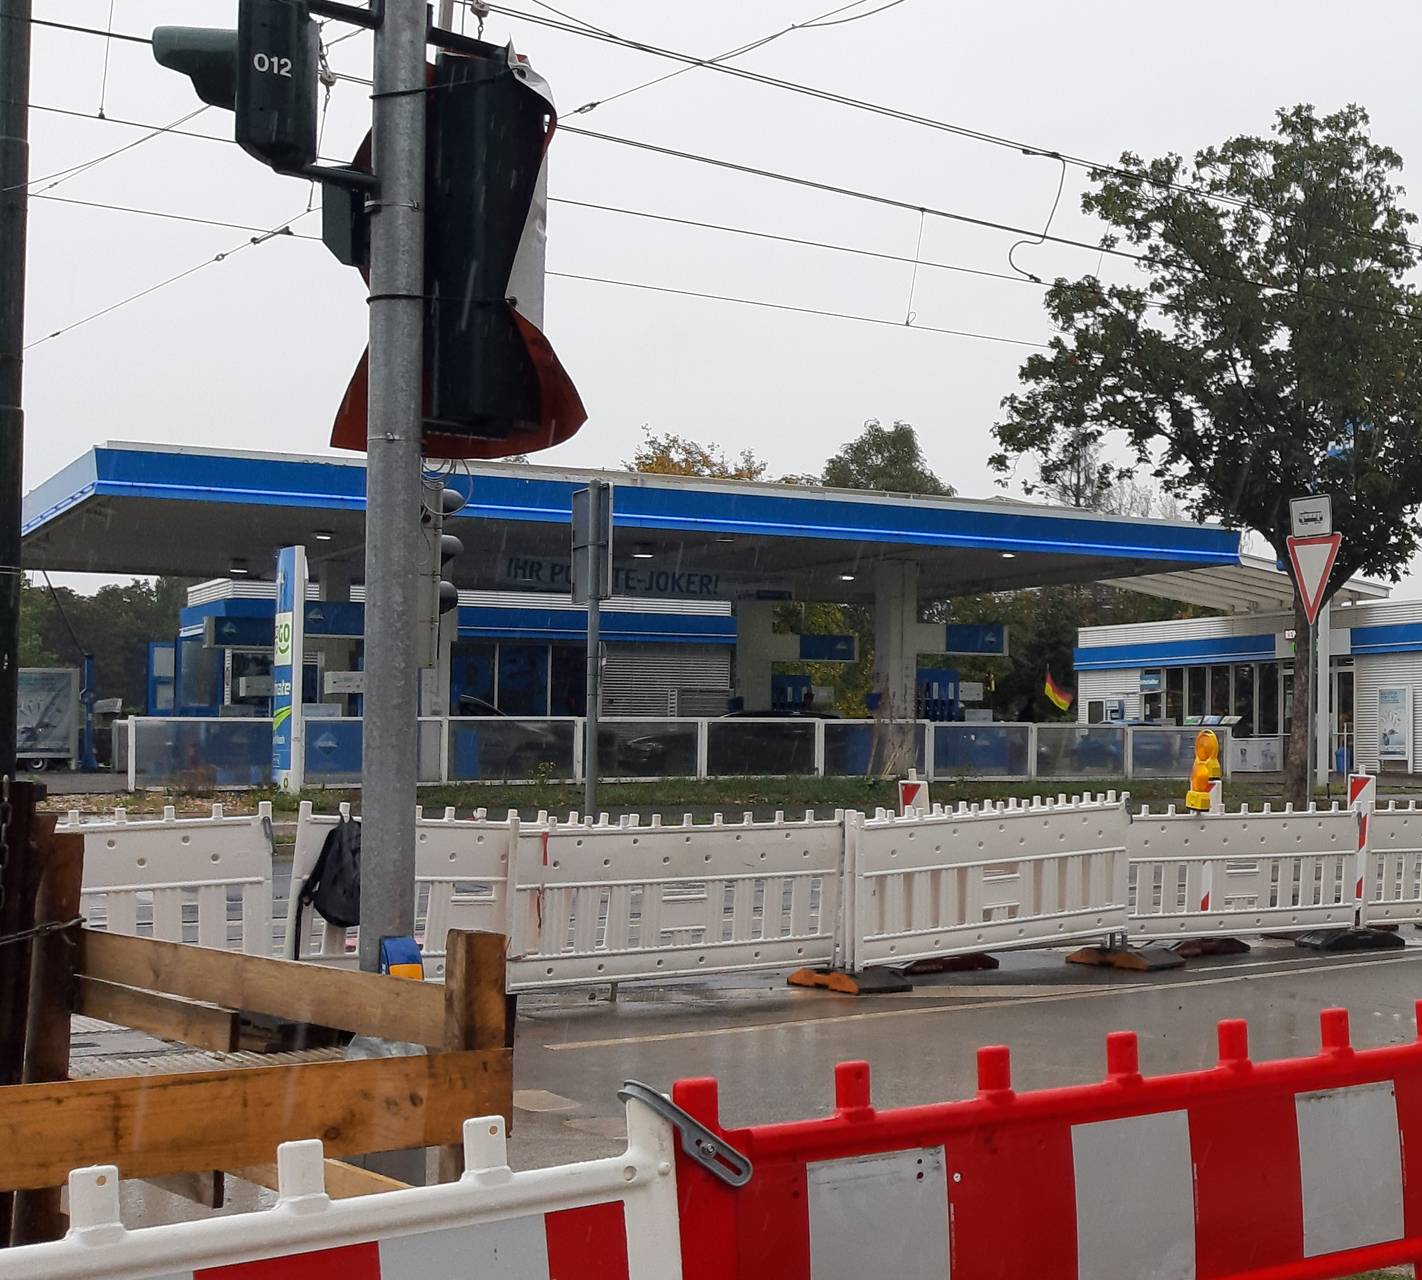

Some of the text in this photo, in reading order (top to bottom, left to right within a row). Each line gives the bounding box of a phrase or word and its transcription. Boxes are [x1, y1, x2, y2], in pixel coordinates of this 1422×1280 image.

[253, 53, 292, 78] 012
[507, 556, 720, 595] IHR PTE-JOKER!
